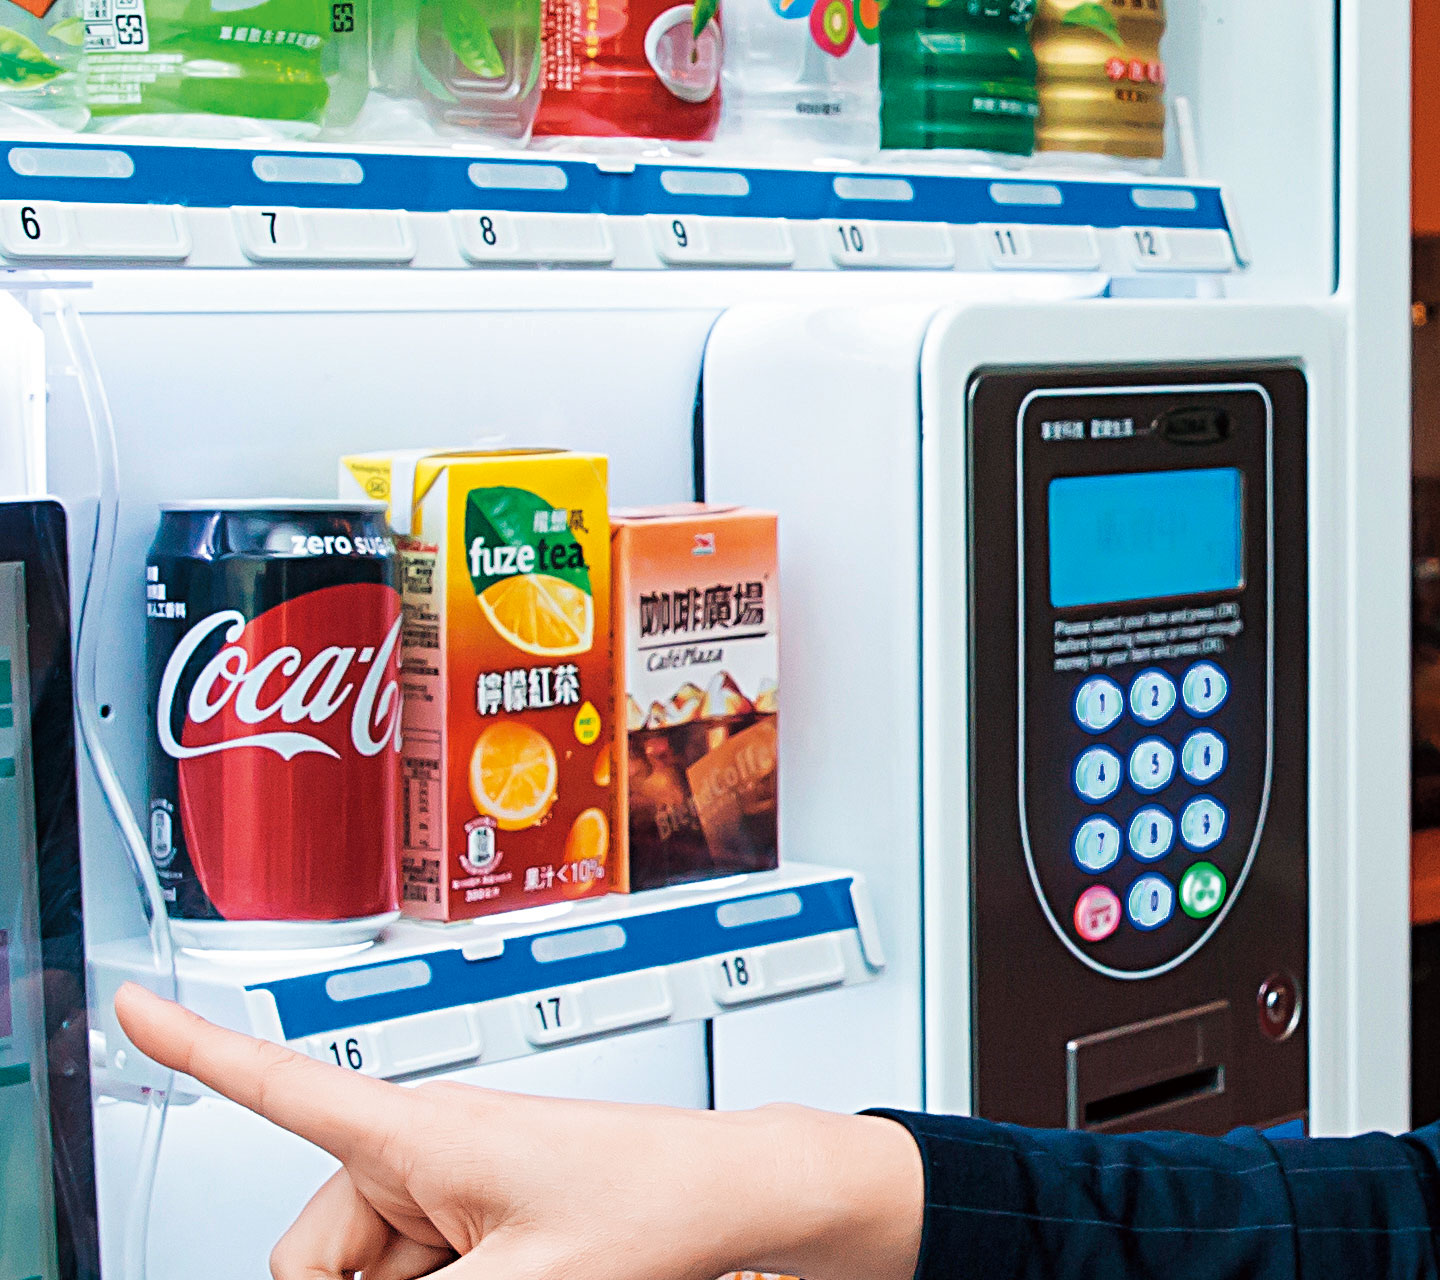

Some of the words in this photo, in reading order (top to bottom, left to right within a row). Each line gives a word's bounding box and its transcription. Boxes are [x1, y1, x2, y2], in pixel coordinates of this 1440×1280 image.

[21, 206, 41, 240] 6
[260, 212, 279, 245] 7
[479, 215, 497, 247] 8
[672, 219, 689, 250] 9
[837, 223, 865, 254] 10
[995, 228, 1019, 256] 11
[1132, 230, 1158, 256] 12
[290, 534, 352, 556] zero
[470, 536, 535, 577] fuze
[537, 539, 584, 571] tea
[640, 581, 764, 638] 咖啡廣場
[476, 664, 581, 715] 檸檬紅茶
[720, 957, 749, 988] 18
[534, 998, 563, 1034] 17
[328, 1037, 364, 1071] 16
